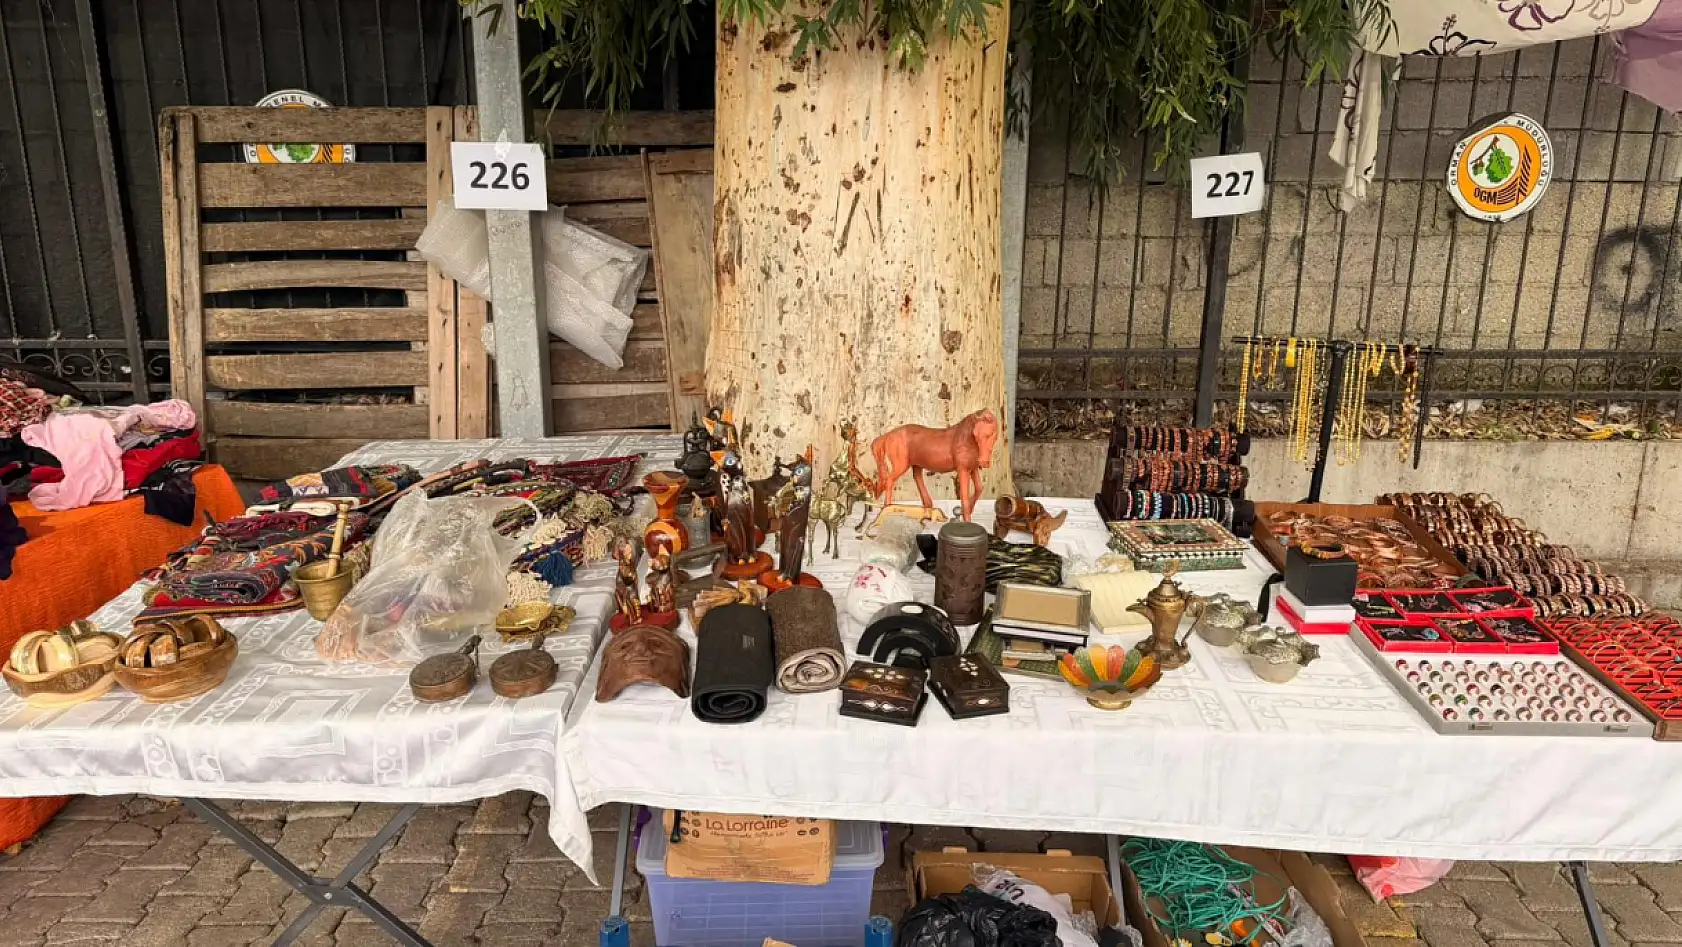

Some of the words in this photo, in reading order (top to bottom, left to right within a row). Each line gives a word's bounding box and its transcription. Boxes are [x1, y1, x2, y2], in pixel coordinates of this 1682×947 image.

[469, 160, 530, 190] 226
[1450, 141, 1466, 186] ORMAN
[1206, 170, 1254, 198] 227
[1473, 187, 1498, 205] OGM
[705, 818, 724, 831] La
[727, 817, 789, 832] Lorraine
